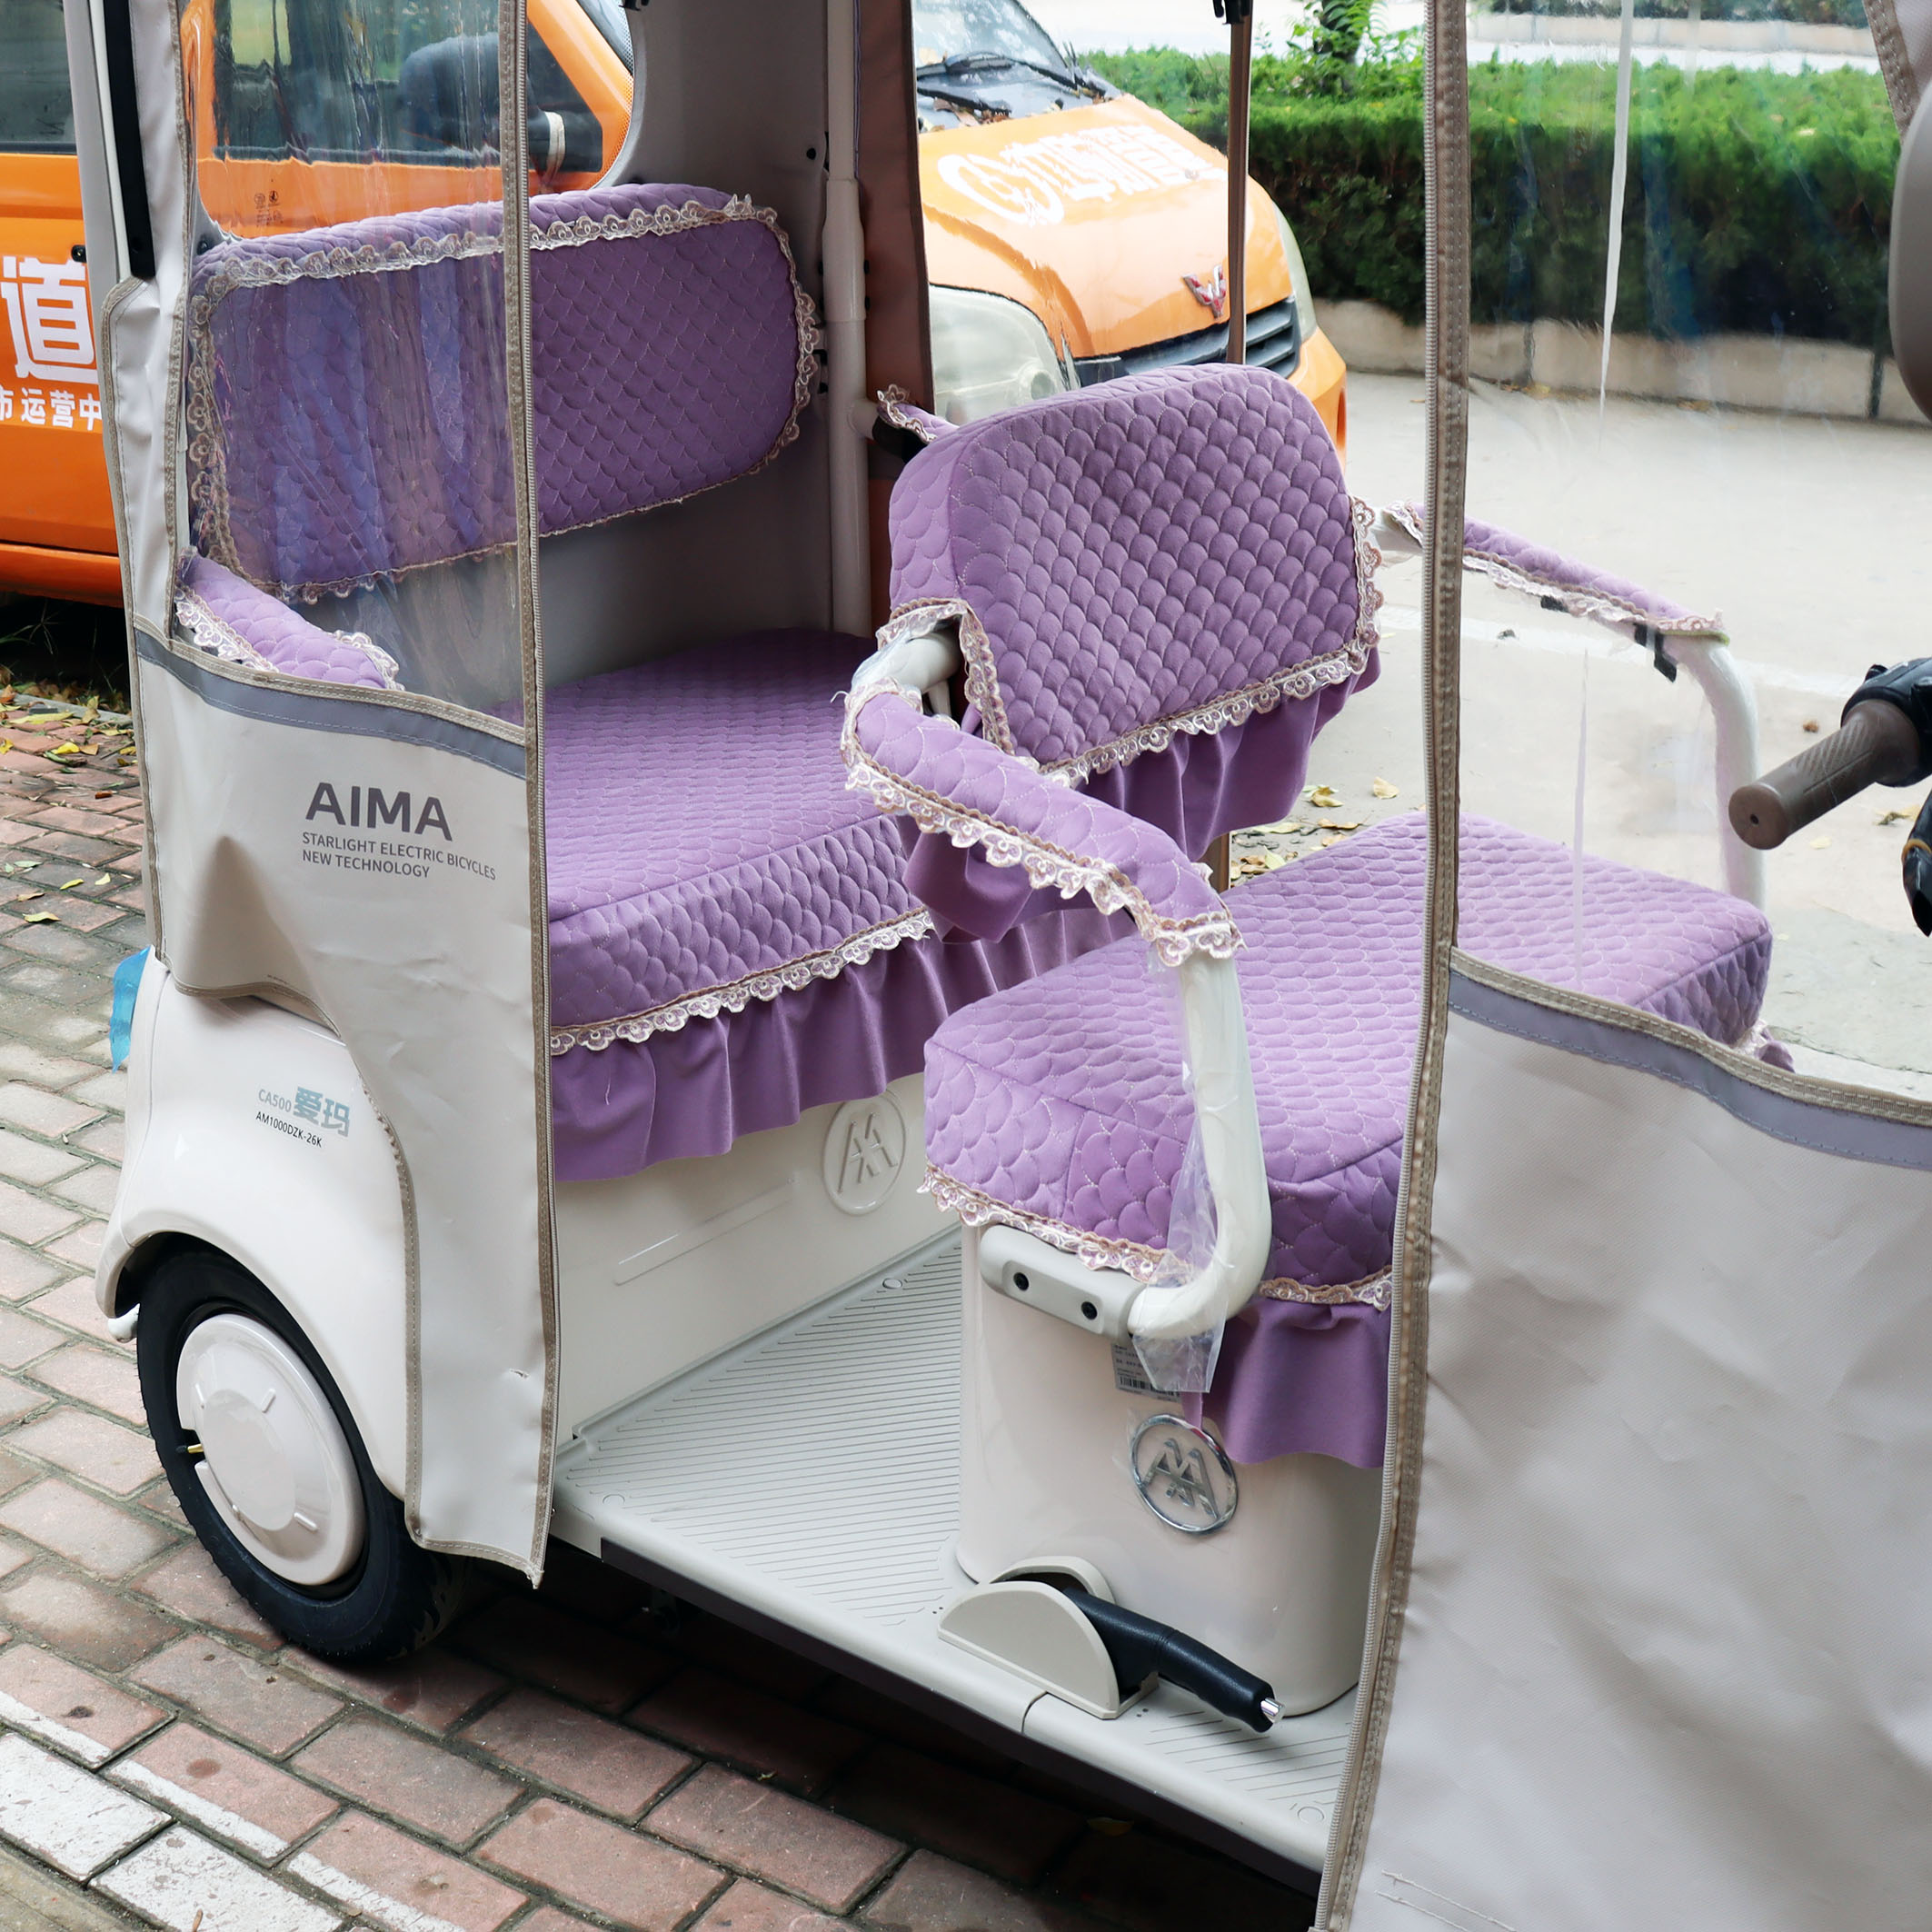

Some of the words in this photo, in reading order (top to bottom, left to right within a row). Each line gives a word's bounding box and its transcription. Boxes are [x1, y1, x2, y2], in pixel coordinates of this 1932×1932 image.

[305, 782, 453, 842] AIMA
[302, 832, 376, 855] STARLIGHT
[380, 842, 443, 863] ELECTRIC
[446, 852, 496, 881] BICYCLES
[302, 850, 332, 864] NEW
[335, 854, 430, 879] TECHNOLOGY
[255, 1110, 323, 1148] AM1000DZK-26K
[258, 1089, 292, 1113] CA500
[293, 1086, 350, 1137] 爱玛
